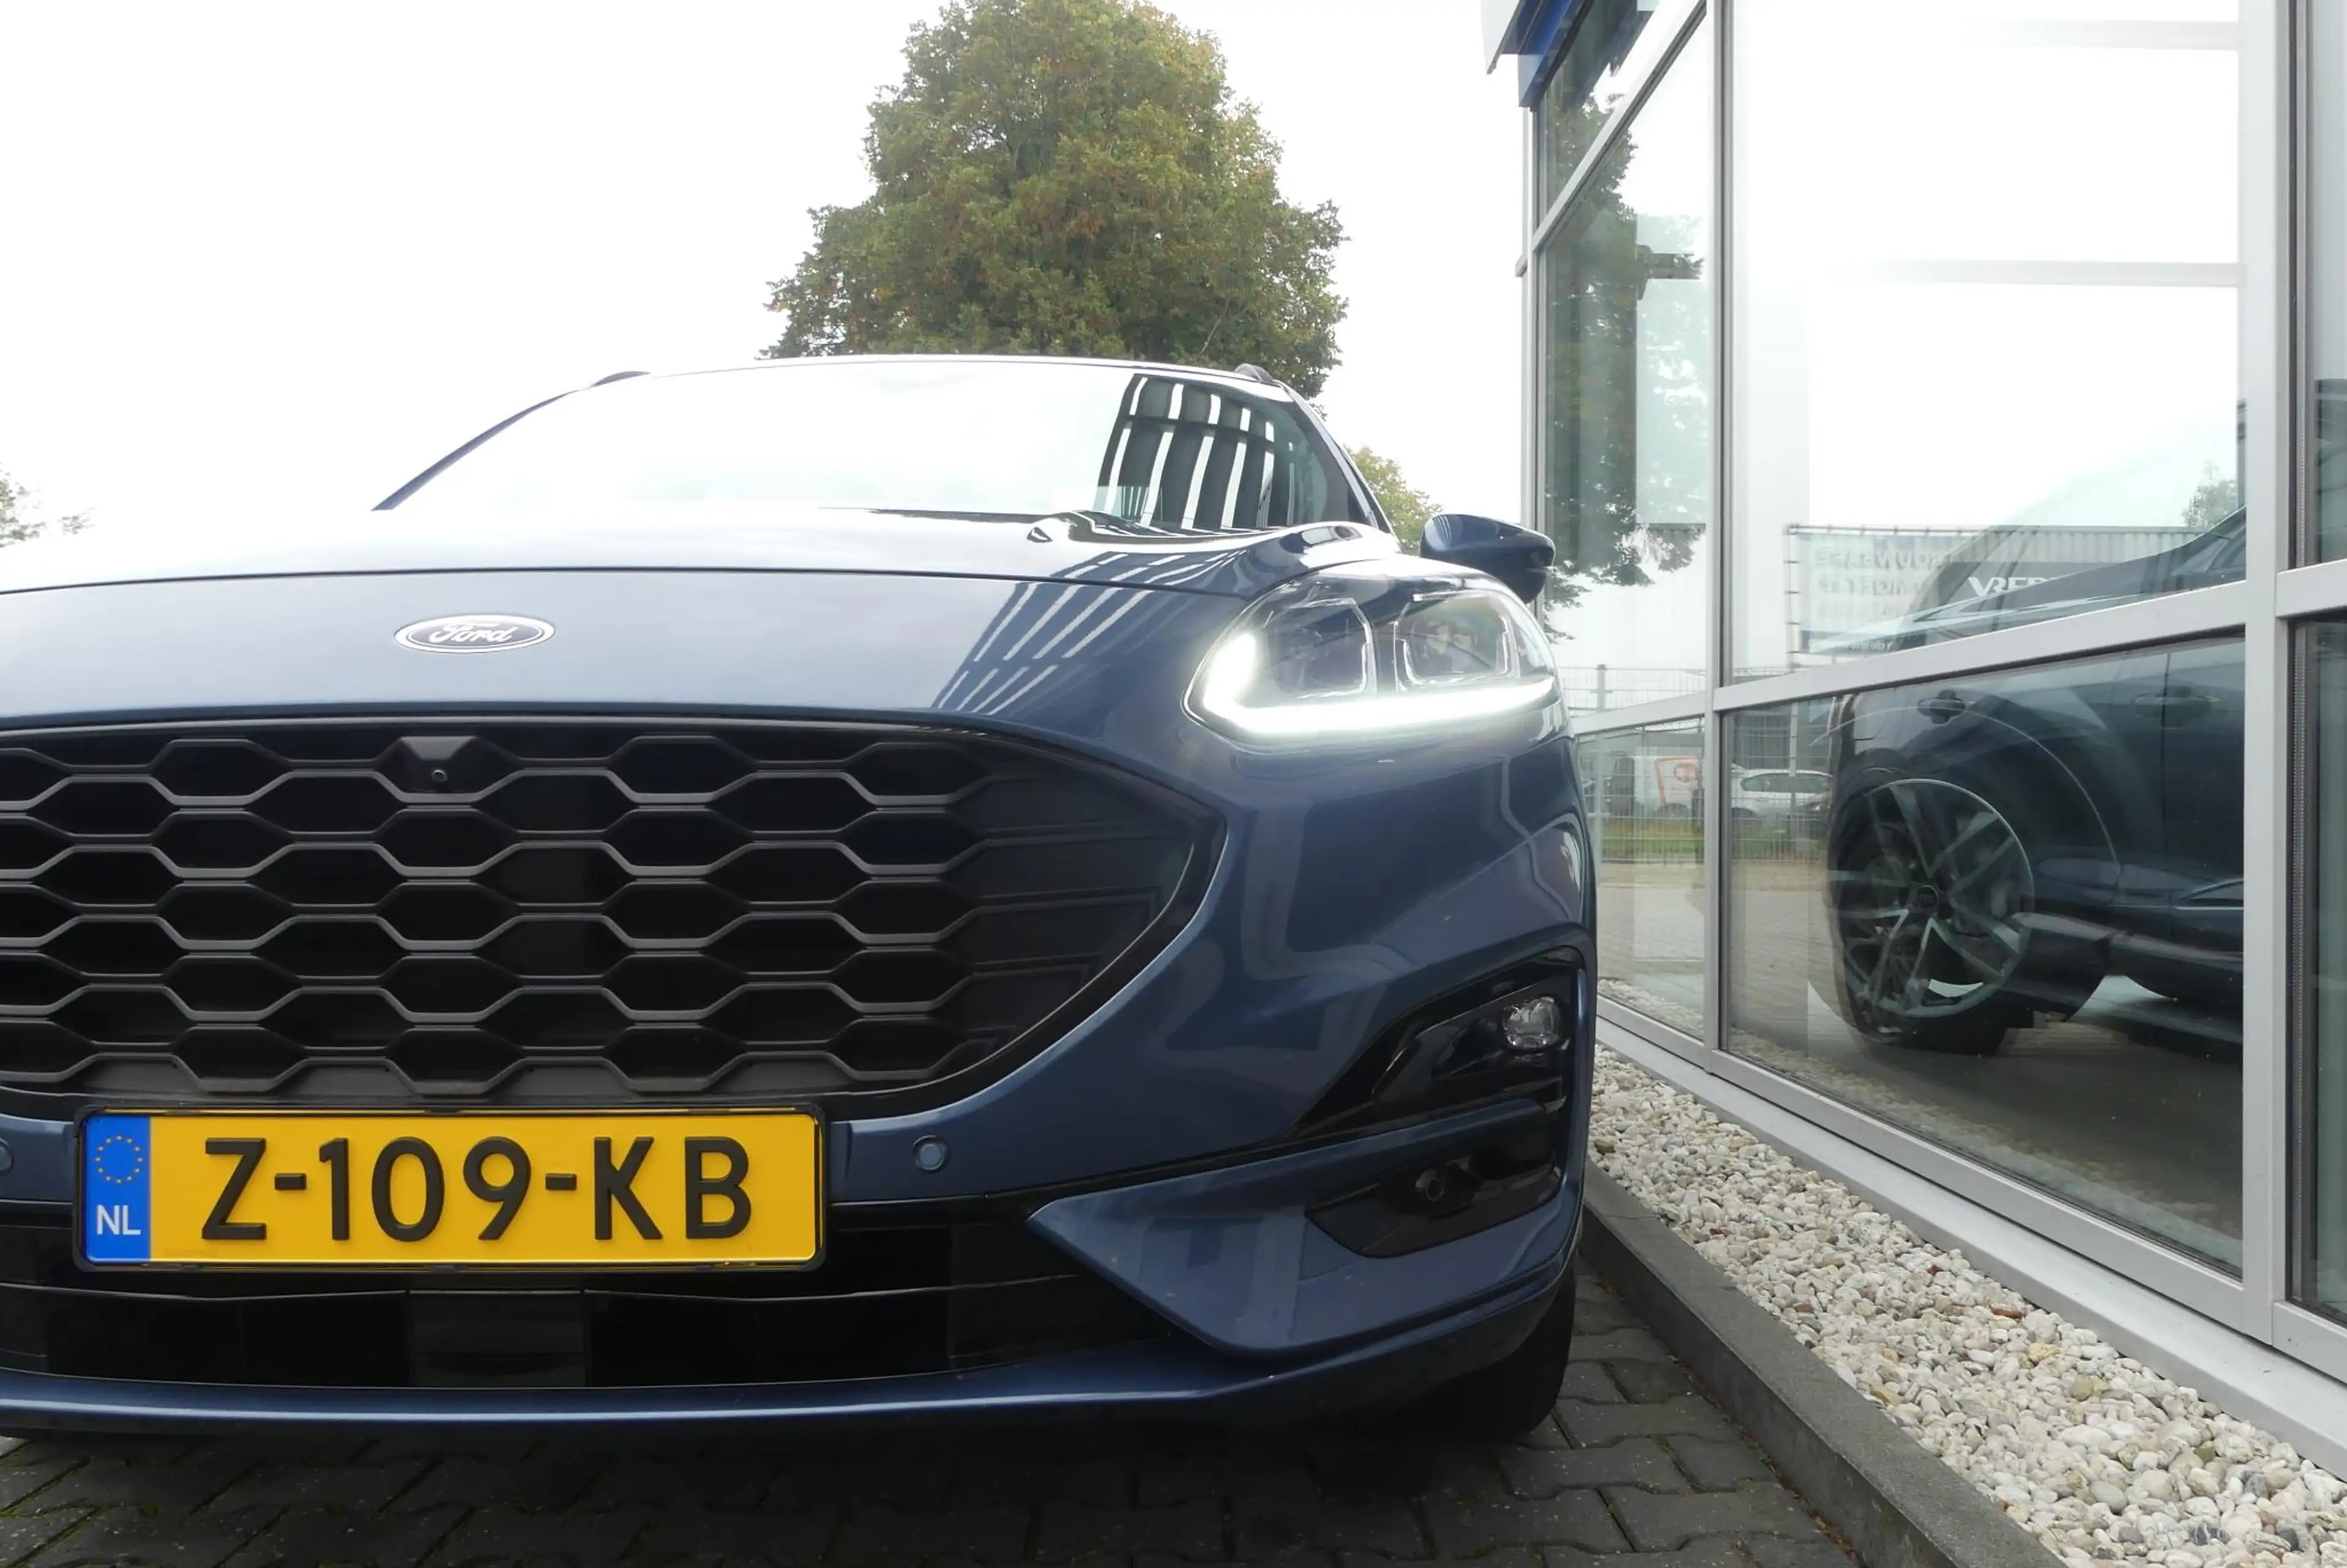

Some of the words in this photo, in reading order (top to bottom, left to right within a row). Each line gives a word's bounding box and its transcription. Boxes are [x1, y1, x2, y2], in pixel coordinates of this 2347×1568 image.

[429, 622, 519, 642] Ford
[201, 1135, 752, 1242] Z-109-KB
[96, 1204, 141, 1236] NL
